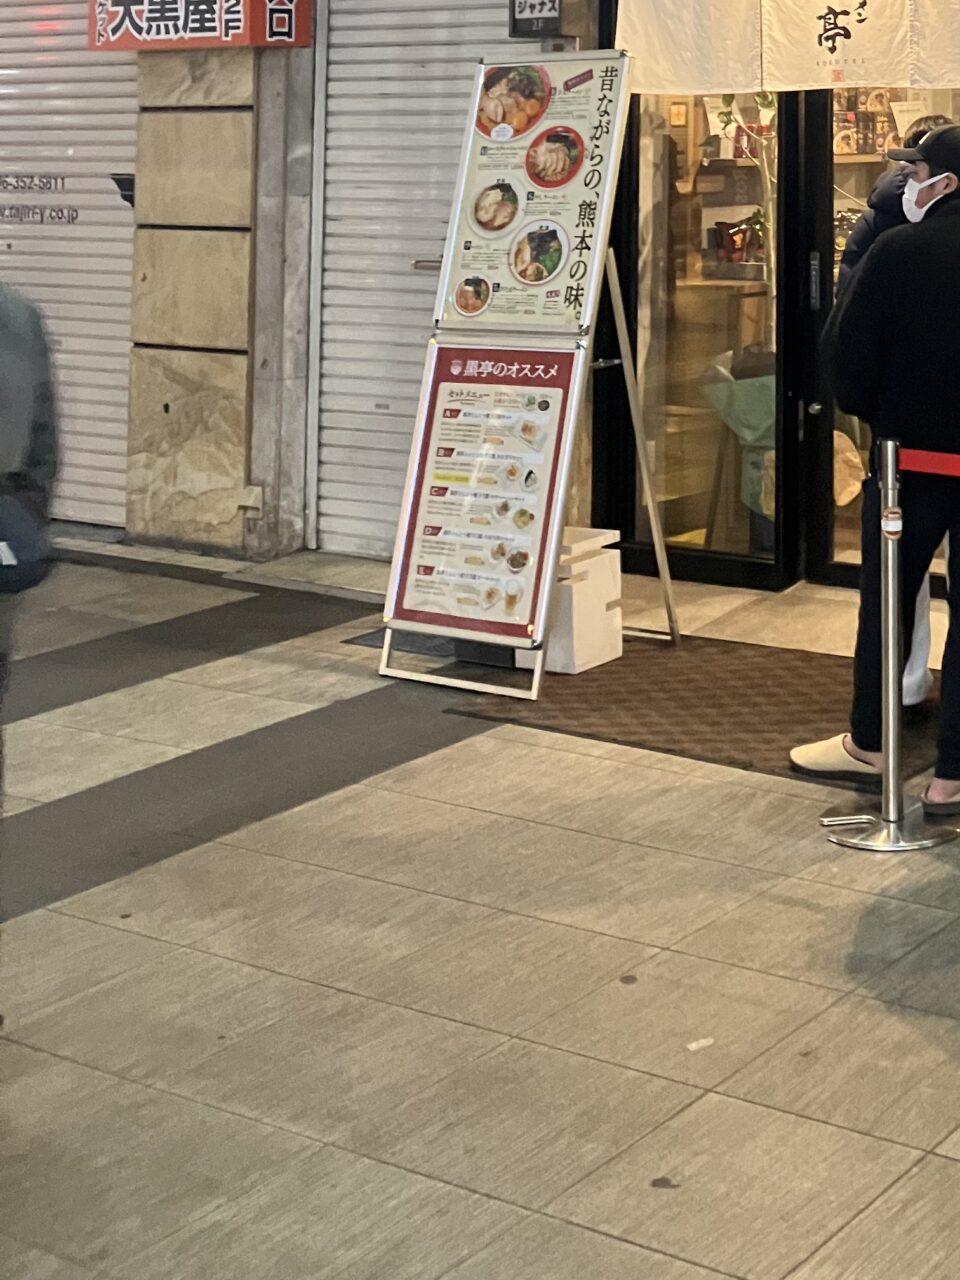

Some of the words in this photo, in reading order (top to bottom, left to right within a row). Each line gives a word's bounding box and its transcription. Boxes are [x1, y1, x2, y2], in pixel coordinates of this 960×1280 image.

[517, 0, 558, 15] ジャナス
[563, 65, 618, 321] 昔ながらの、熊本の味。
[463, 359, 559, 380] 黒亭のオススメ
